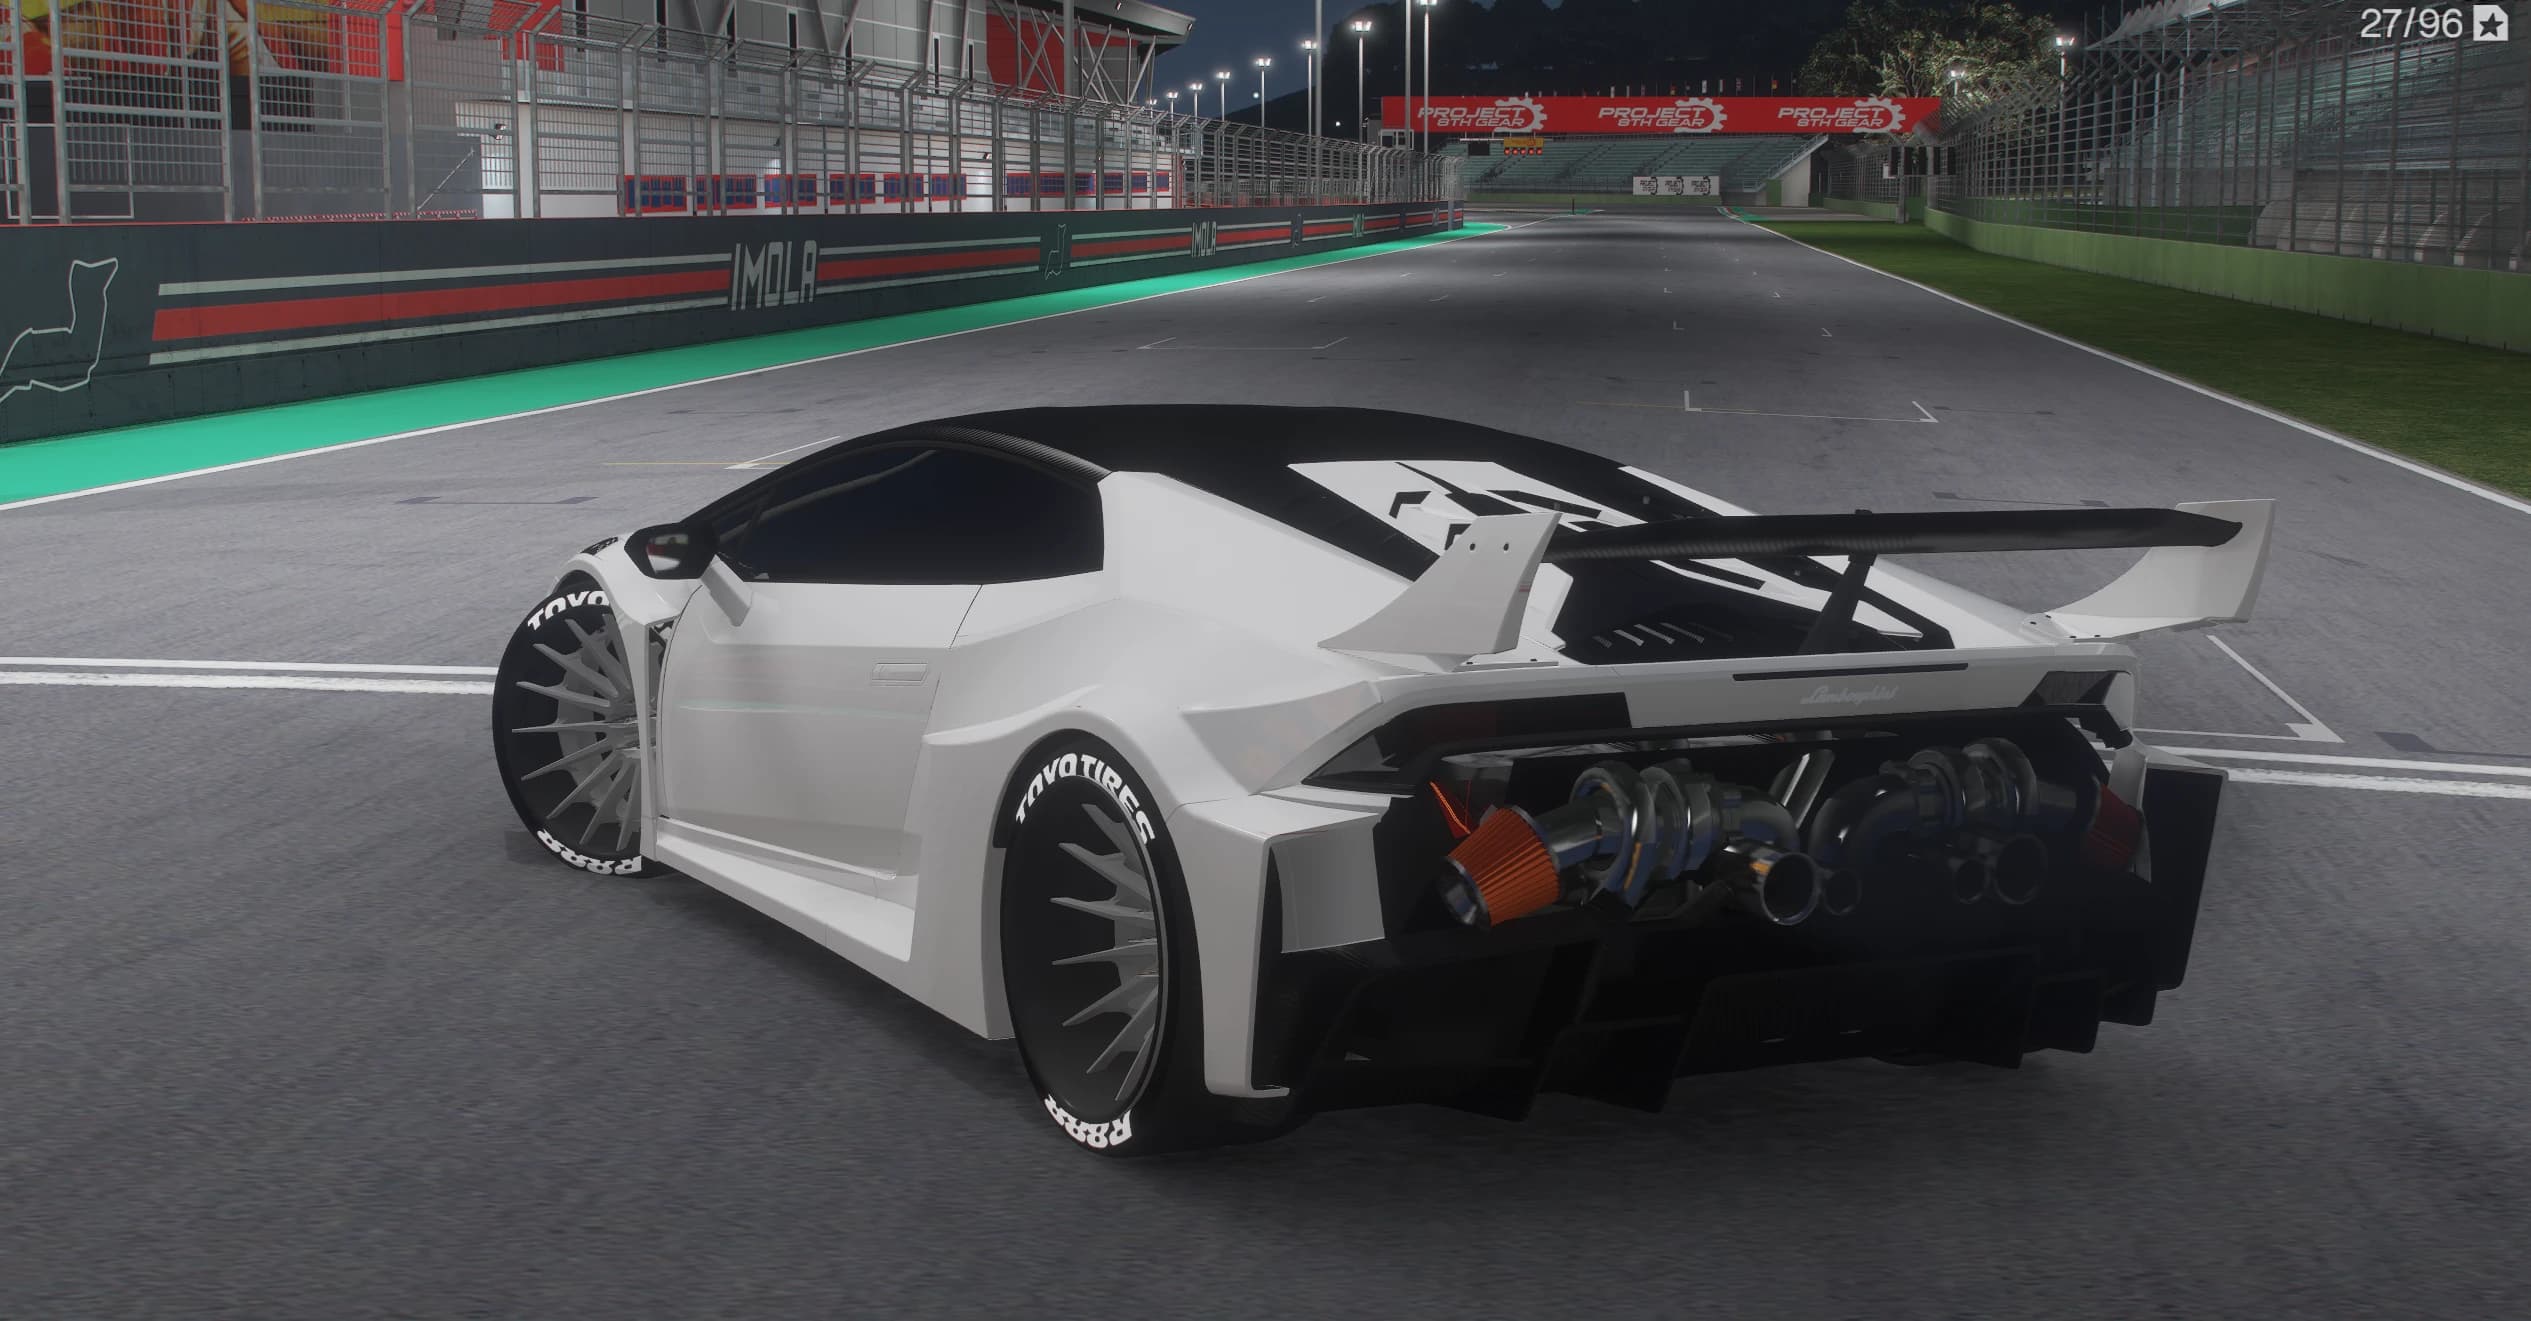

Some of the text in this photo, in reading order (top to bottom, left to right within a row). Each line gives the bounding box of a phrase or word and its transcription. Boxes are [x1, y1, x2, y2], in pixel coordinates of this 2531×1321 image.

[1418, 107, 1526, 119] PROJECT
[1598, 107, 1706, 119] PROJECT
[1777, 107, 1885, 119] PROJECT
[1475, 118, 1525, 127] GEAR
[1656, 118, 1705, 127] GEAR
[1834, 118, 1884, 127] GEAR
[1191, 220, 1217, 257] IMOLA
[731, 240, 817, 311] IMOLA
[527, 590, 610, 631] TOYO
[1015, 753, 1156, 845] TOYO TIRES
